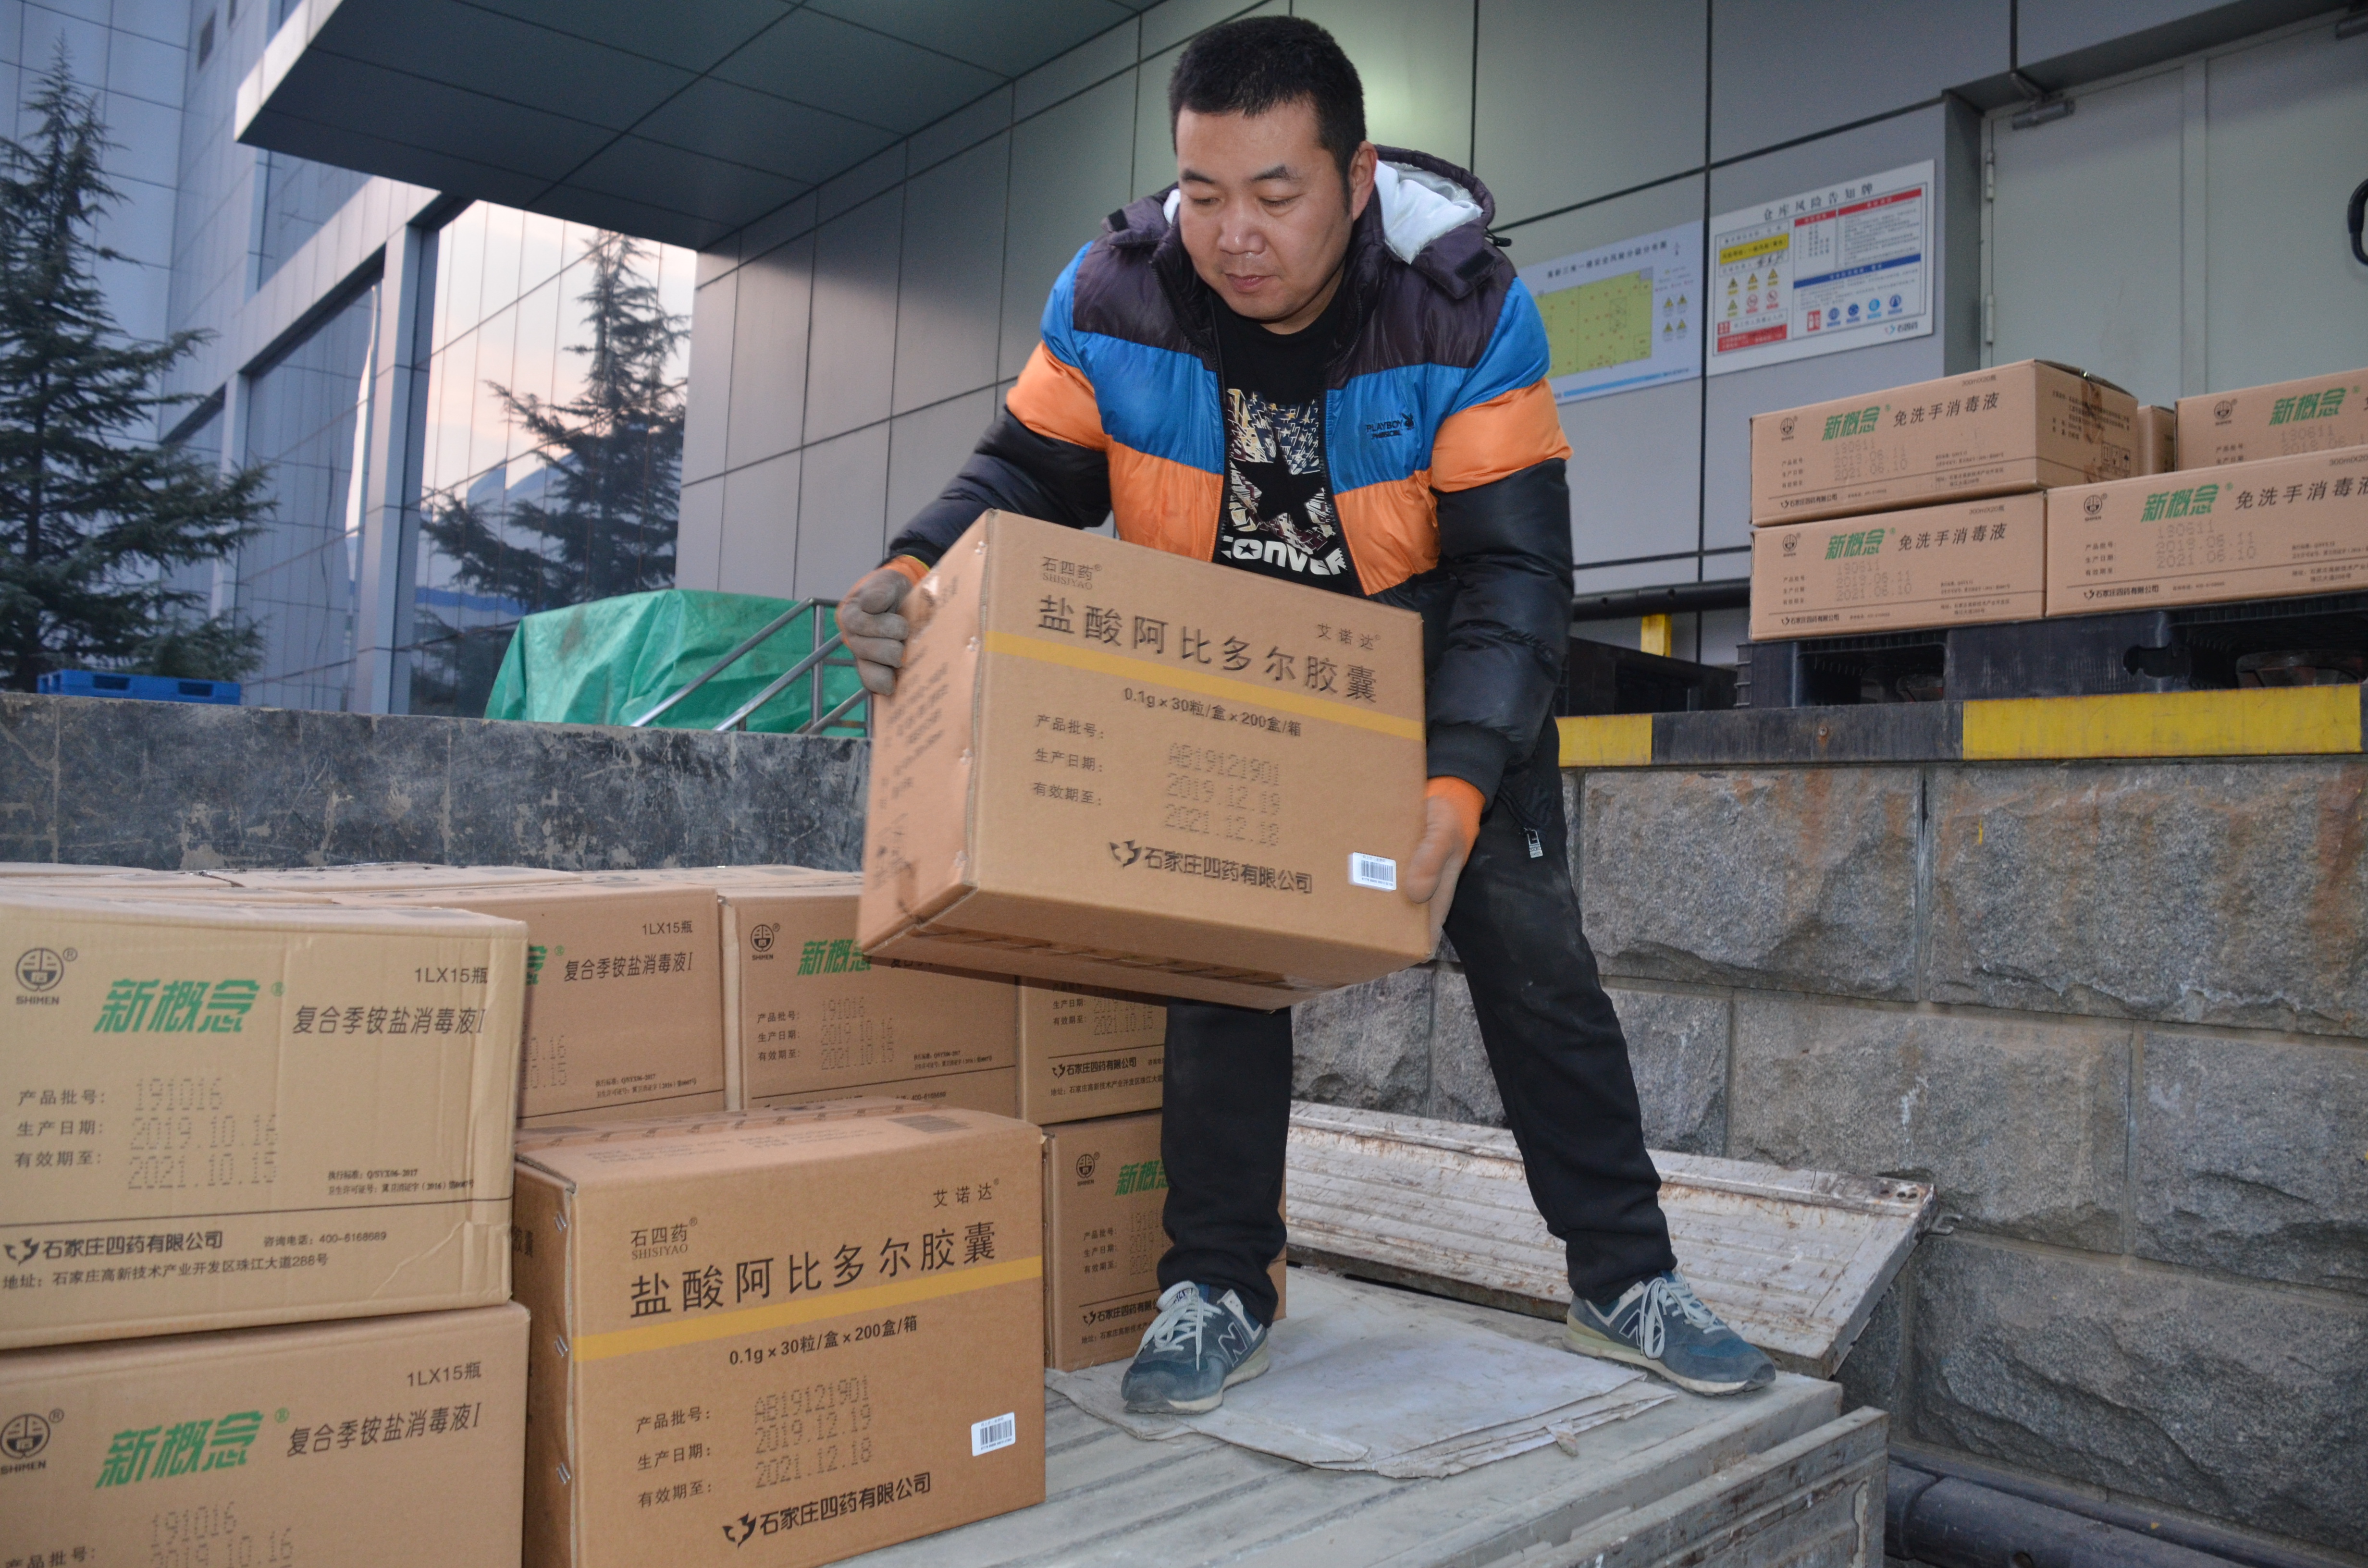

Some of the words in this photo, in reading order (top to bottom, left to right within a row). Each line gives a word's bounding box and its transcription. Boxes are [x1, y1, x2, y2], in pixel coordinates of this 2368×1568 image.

[1822, 406, 1880, 441] 新概念
[1893, 392, 1999, 427] 免洗手消毒液
[2269, 387, 2347, 426] 新概念
[1366, 419, 1403, 432] PLAYBOY
[2141, 483, 2220, 523] 新概念
[1825, 528, 1885, 560] 新概念
[1898, 523, 2007, 551] 免洗手消毒液
[1042, 556, 1094, 581] 石四药
[1043, 573, 1093, 590] SHISIYAO
[1038, 595, 1377, 703] 盐酸阿比多尔胶囊
[1318, 623, 1374, 650] 艾诺达
[1144, 846, 1312, 894] 石家庄四药有限公司
[642, 920, 692, 935] 1LX15瓶
[415, 967, 488, 984] 1LX15瓶
[16, 996, 60, 1005] SHIMEN
[94, 979, 260, 1033] 新概念
[1067, 1057, 1136, 1075] 石家庄四药有限公司
[18, 1090, 105, 1106] 产品批号：
[135, 1078, 222, 1111] 191016
[17, 1120, 103, 1137] 生产日期：
[130, 1115, 279, 1150] 2019.10.16
[15, 1151, 101, 1168] 有效期至：
[128, 1152, 277, 1189] 2021.10.15
[933, 1182, 993, 1209] 艾诺达
[43, 1231, 223, 1260] 石家庄四药有限公司
[630, 1224, 688, 1248] 石四药
[632, 1244, 688, 1260] SHISIYAO
[630, 1221, 996, 1318] 盐酸阿比多尔胶囊
[407, 1361, 481, 1387] 1LX15瓶
[637, 1406, 710, 1434] 产品批号：
[754, 1376, 869, 1425] AB19121901
[95, 1410, 264, 1489] 新概念
[637, 1443, 711, 1471] 生产日期：
[755, 1404, 871, 1455] 2019.12.19
[0, 1461, 46, 1475] SHIMEN
[638, 1480, 712, 1509] 有效期至：
[755, 1437, 872, 1489] 2021.12.18
[152, 1501, 237, 1538] 191016
[759, 1471, 931, 1536] 石家庄四药有限公司
